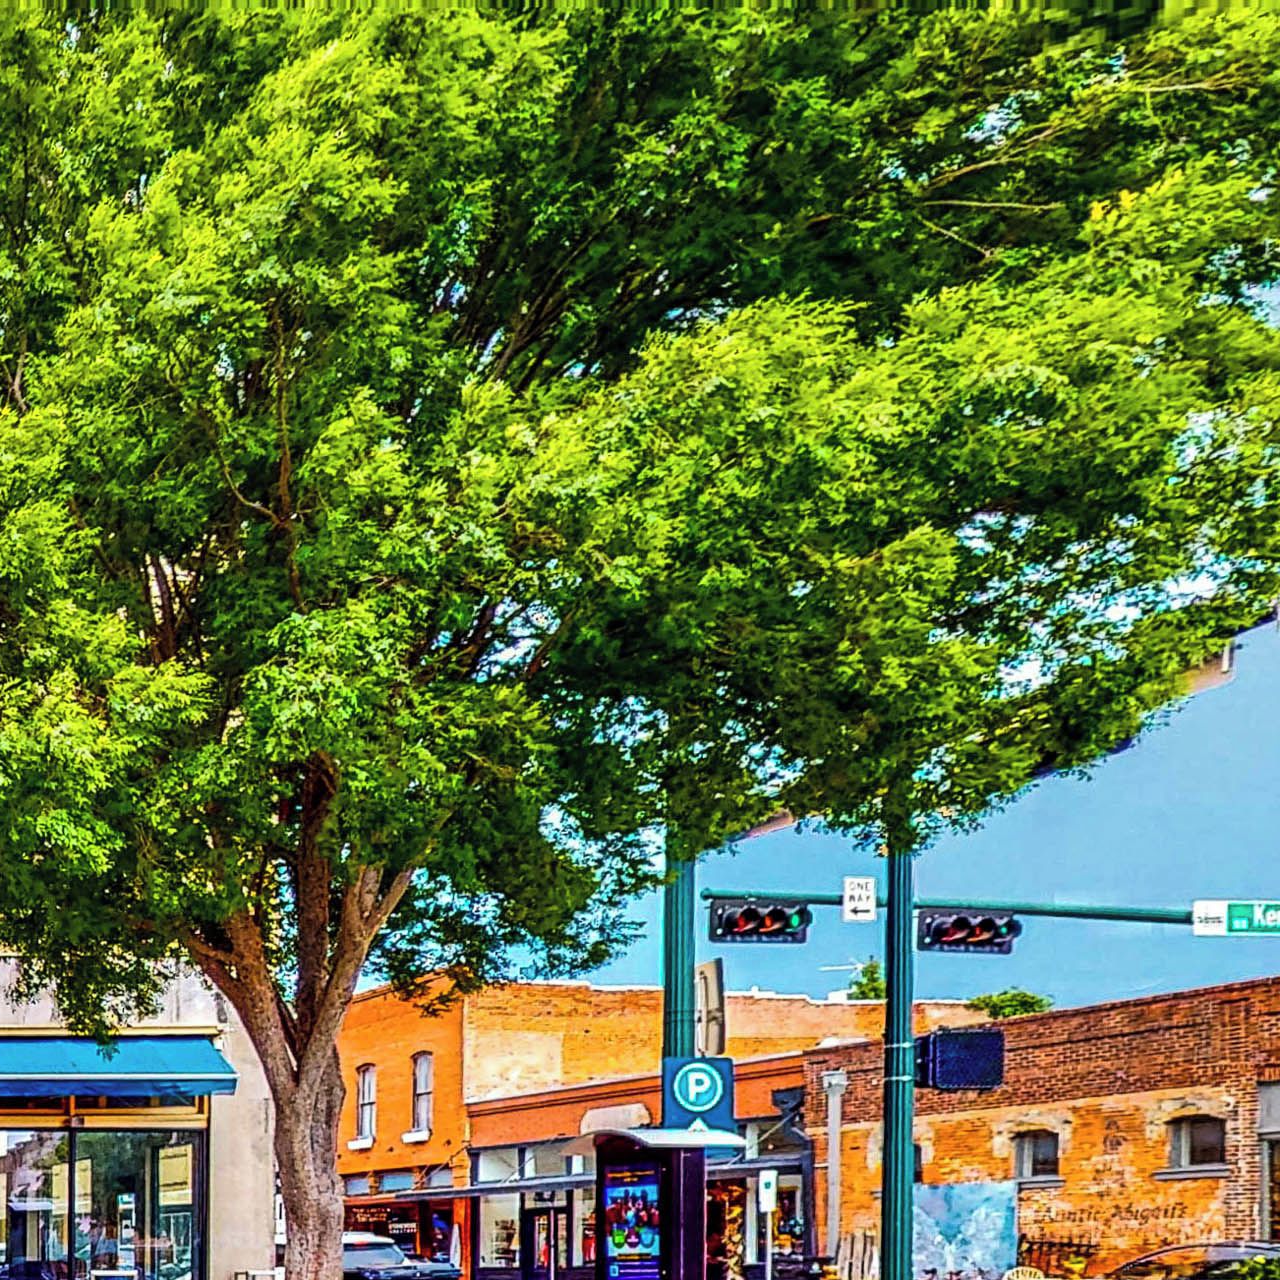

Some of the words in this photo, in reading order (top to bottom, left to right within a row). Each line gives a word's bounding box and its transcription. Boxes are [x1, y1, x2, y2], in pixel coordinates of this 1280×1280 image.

[849, 881, 871, 892] ONE
[848, 894, 871, 903] WAY
[1253, 903, 1280, 929] Ke
[687, 1071, 712, 1102] P
